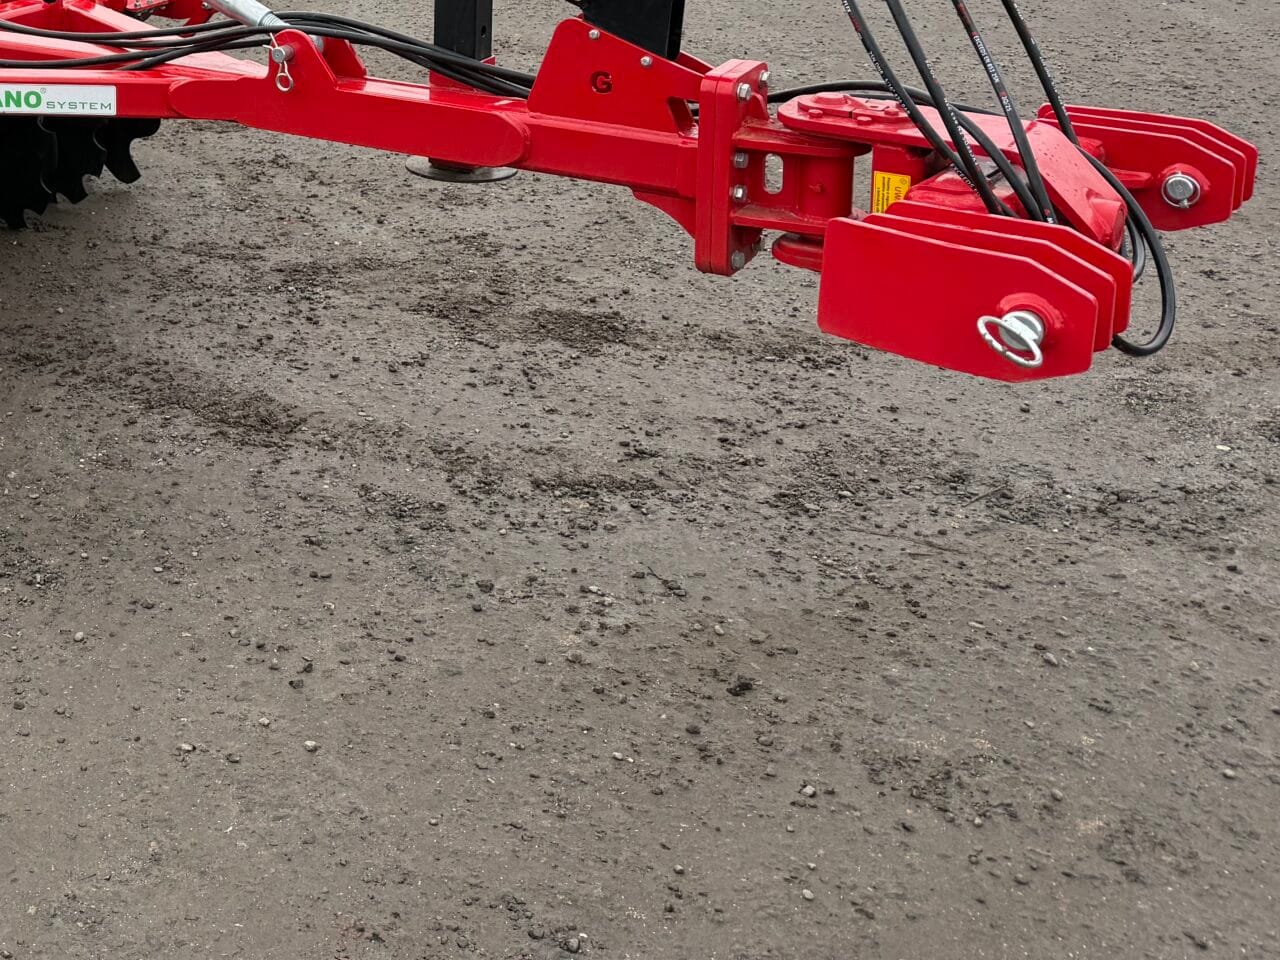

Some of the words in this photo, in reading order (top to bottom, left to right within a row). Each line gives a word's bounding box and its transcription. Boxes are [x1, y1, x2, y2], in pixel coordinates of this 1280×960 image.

[591, 70, 613, 94] G
[46, 101, 112, 110] SYSTEM
[894, 186, 903, 201] UW
